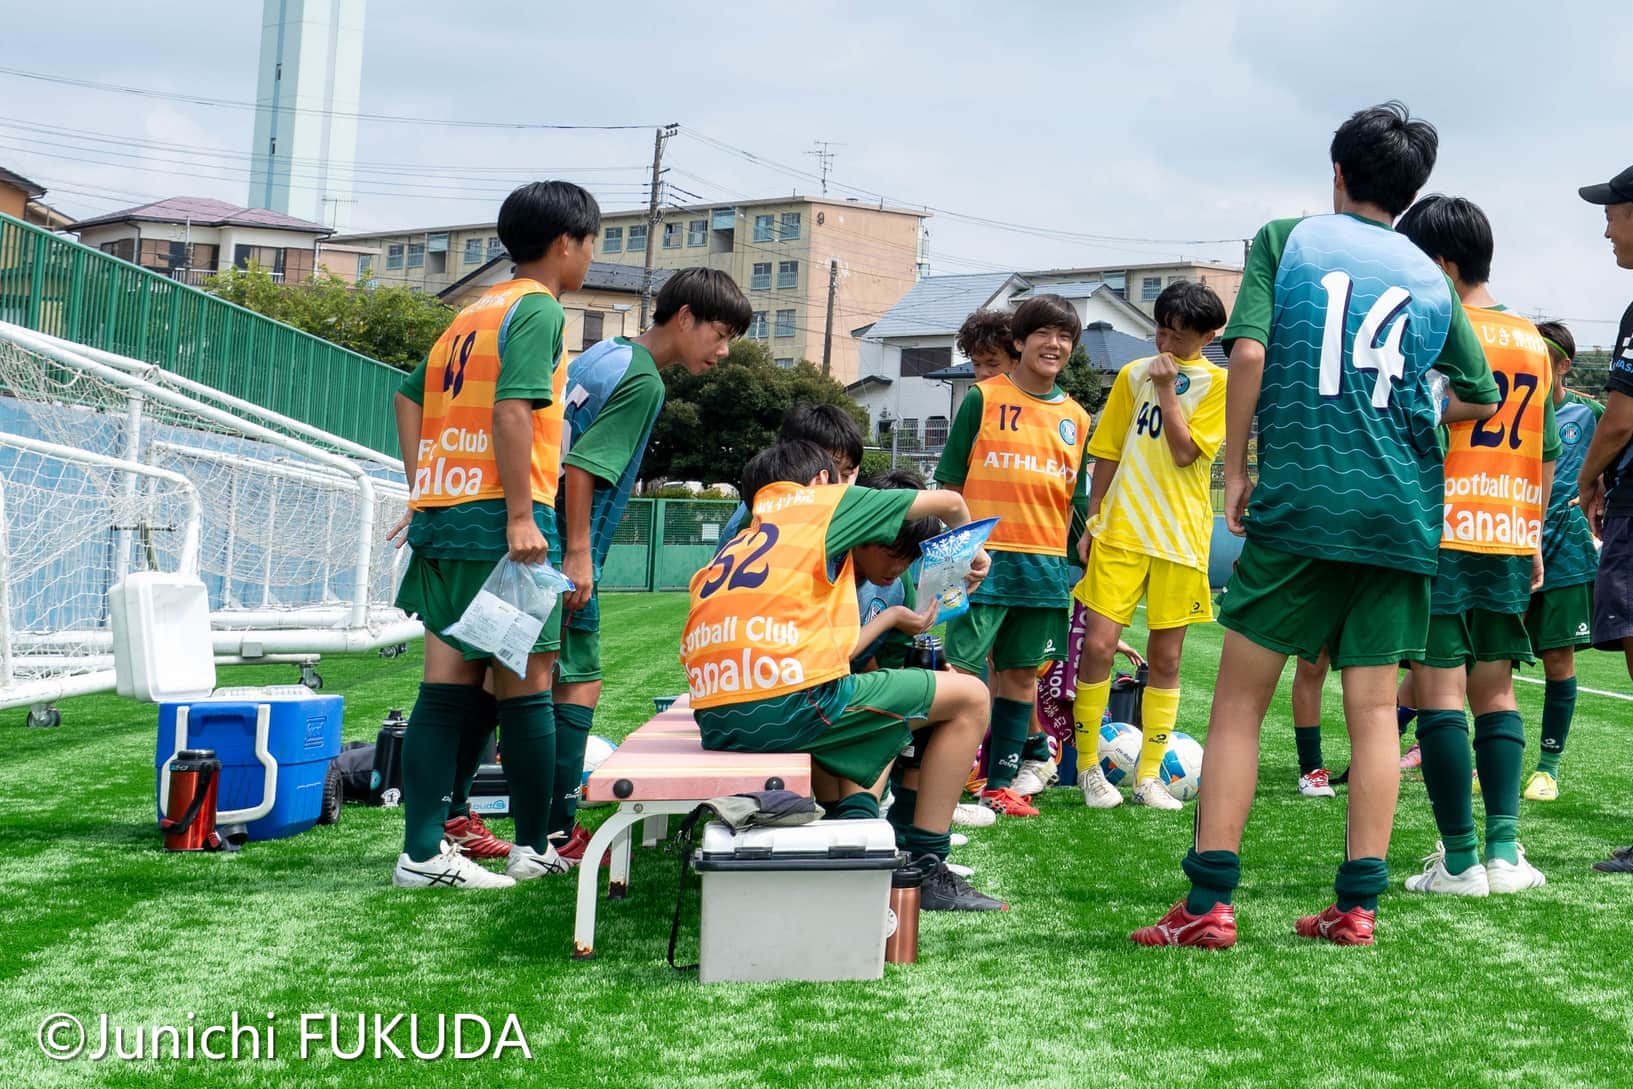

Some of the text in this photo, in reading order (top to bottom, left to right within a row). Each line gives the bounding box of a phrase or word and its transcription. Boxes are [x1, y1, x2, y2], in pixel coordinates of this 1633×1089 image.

[1318, 271, 1412, 411] 14
[999, 404, 1022, 431] 17
[1137, 401, 1163, 439] 40
[1470, 369, 1538, 450] 27
[441, 427, 489, 453] Club
[701, 523, 779, 599] 52
[745, 616, 799, 647] Club
